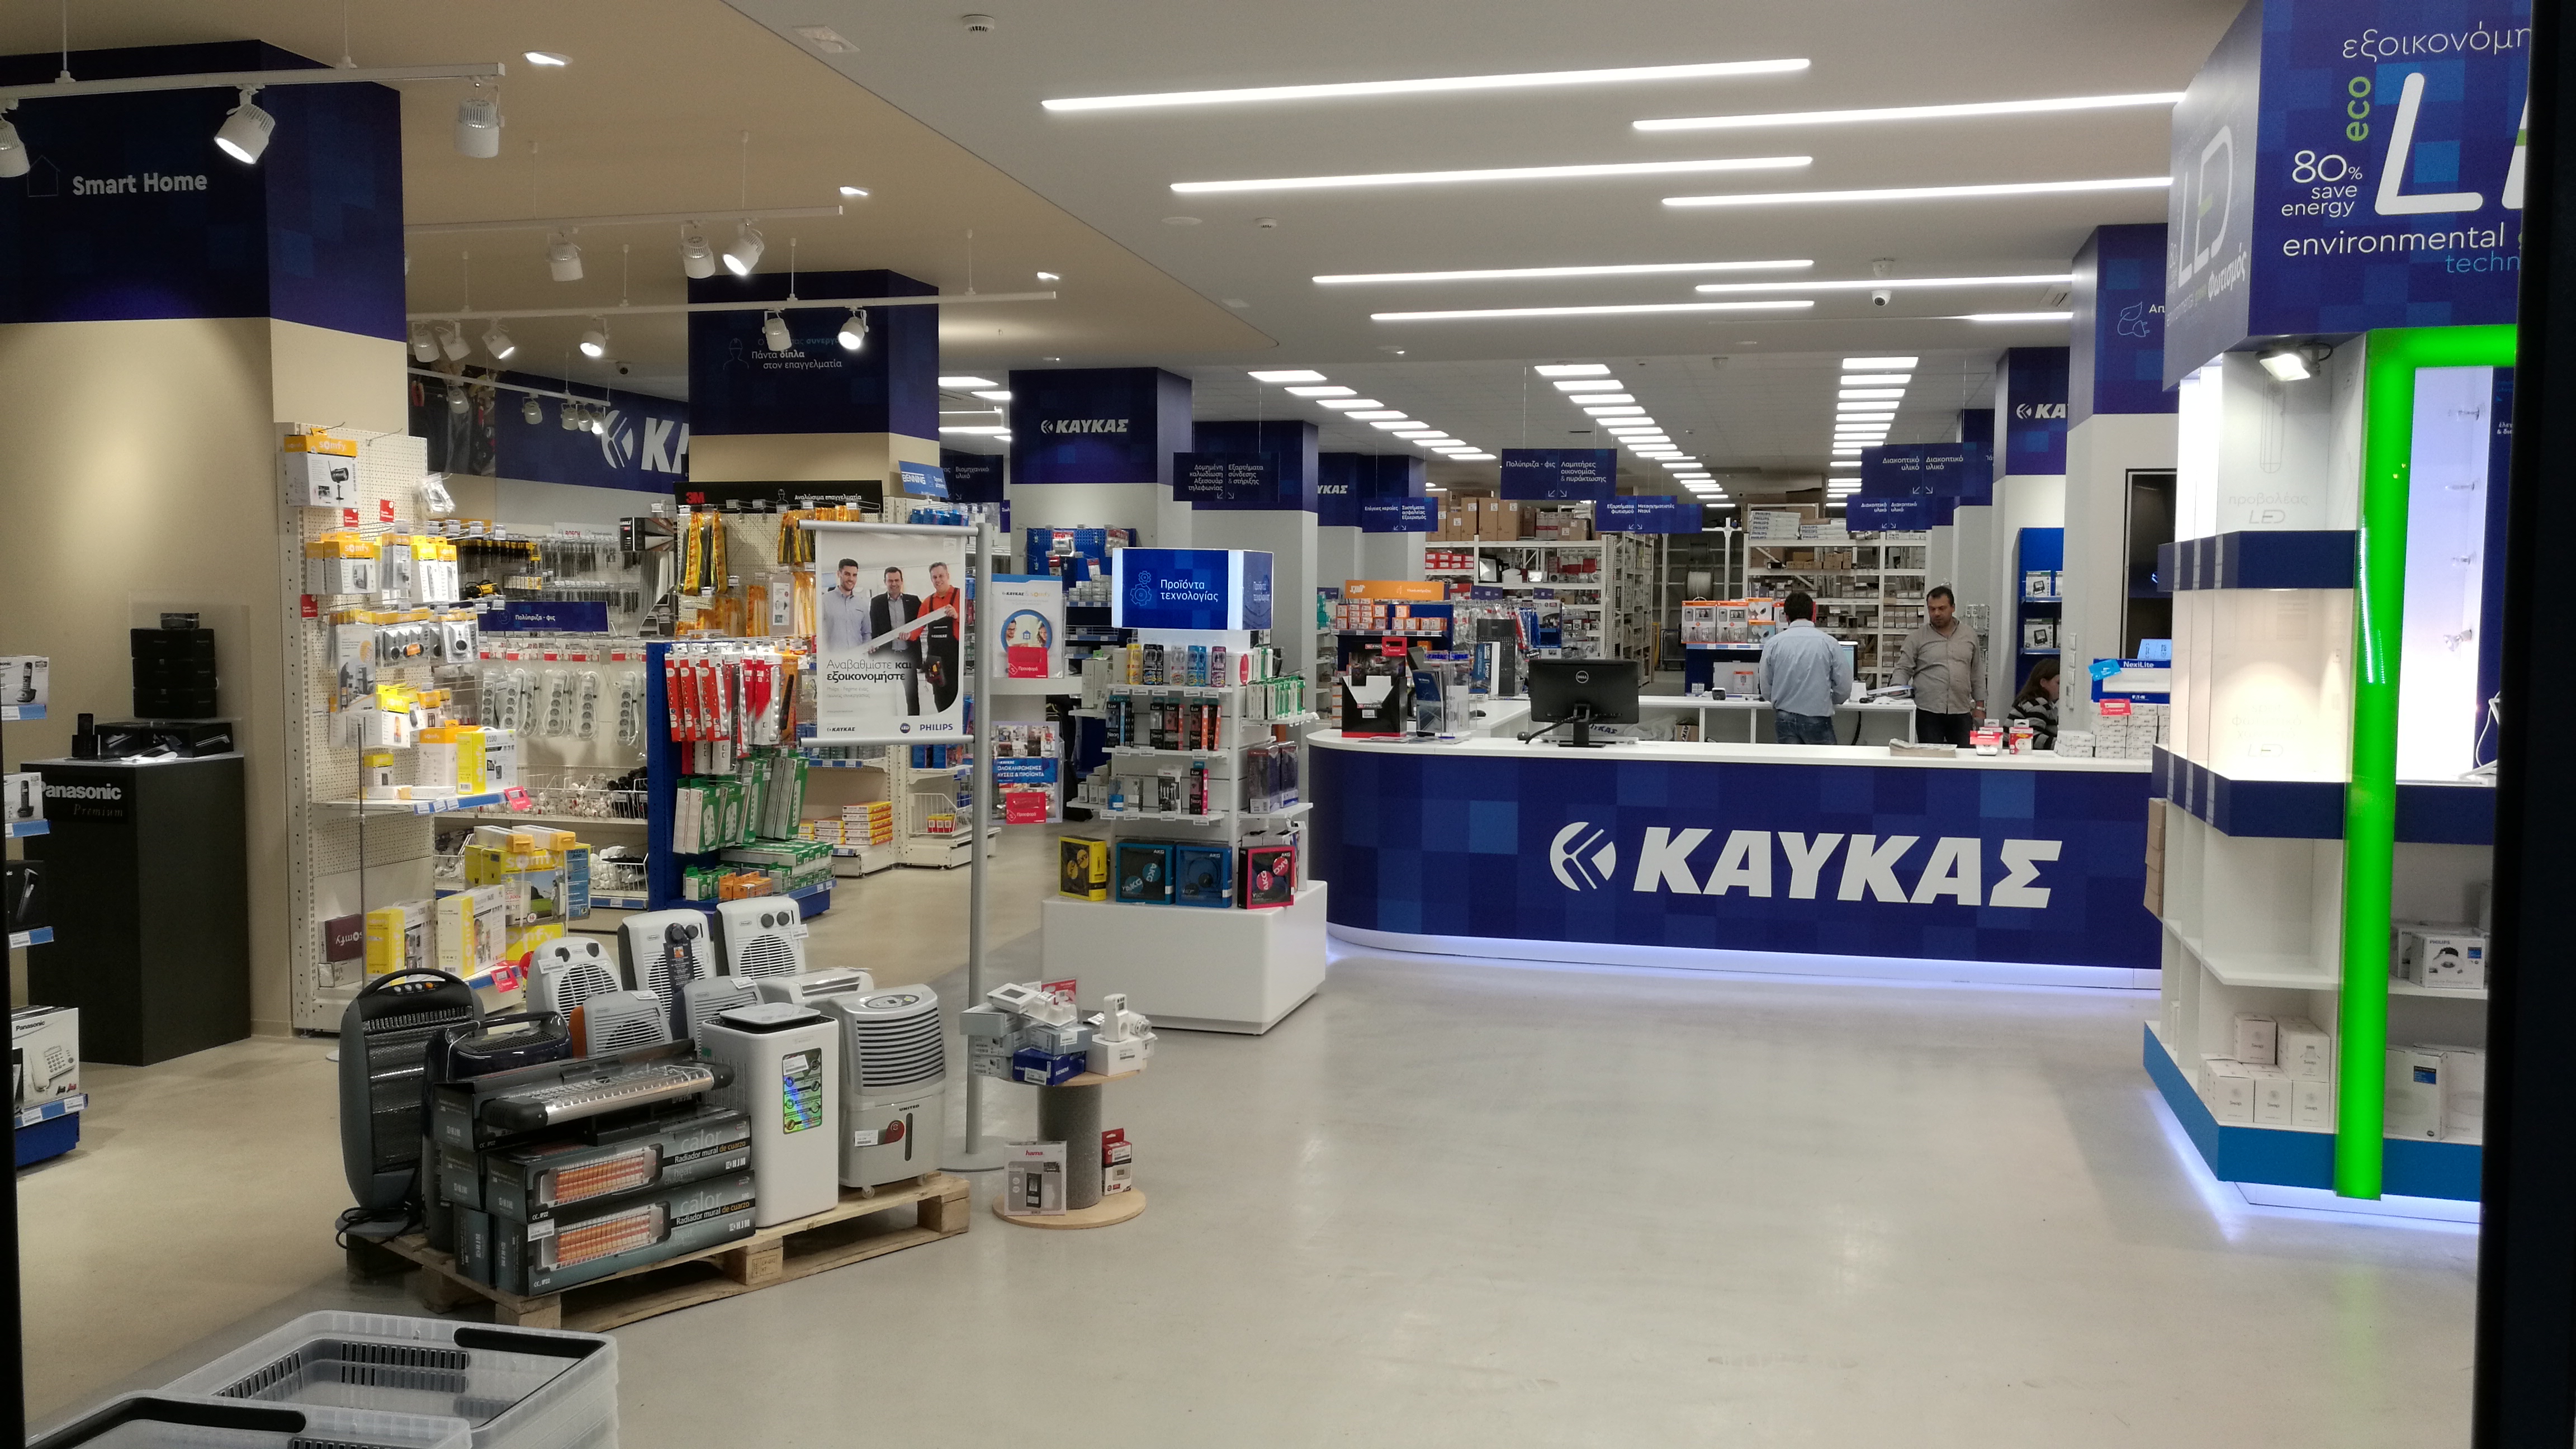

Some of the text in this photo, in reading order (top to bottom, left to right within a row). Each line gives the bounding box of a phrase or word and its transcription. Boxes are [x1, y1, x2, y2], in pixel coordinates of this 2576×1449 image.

[2346, 76, 2371, 141] eco
[72, 172, 207, 196] Smart Home
[2311, 185, 2357, 198] save
[2281, 200, 2355, 217] energy
[2283, 222, 2504, 256] environmental
[752, 349, 805, 359] Πάντα δίπλα
[785, 358, 842, 370] επαγγελματία
[1055, 419, 1129, 433] ΚΑΥΚΑΣ
[1882, 456, 1920, 464] Διακοπτικό
[1926, 454, 1963, 463] Διακοπτικό
[902, 474, 926, 485] BENNING
[685, 492, 705, 504] 3M
[2229, 493, 2308, 506] προβολέας
[2248, 509, 2285, 524] LED
[345, 544, 370, 552] somfy
[1161, 579, 1205, 591] Προϊόντα
[1160, 591, 1219, 603] τεχνολογίας
[826, 659, 892, 671] Αναβαθμίστε
[827, 671, 905, 683] εξοικονομήστε
[74, 803, 124, 817] Premium
[1633, 826, 2063, 908] ΚΑΥΚΑΣ
[16, 1020, 45, 1031] Panasonic
[680, 1127, 722, 1153] calor
[674, 1140, 746, 1164] Radiador mural de cuarzo
[732, 1157, 746, 1168] HJM
[680, 1190, 722, 1215] calor
[676, 1200, 750, 1225] Radiador mural de cuarzo
[736, 1219, 750, 1230] HJM
